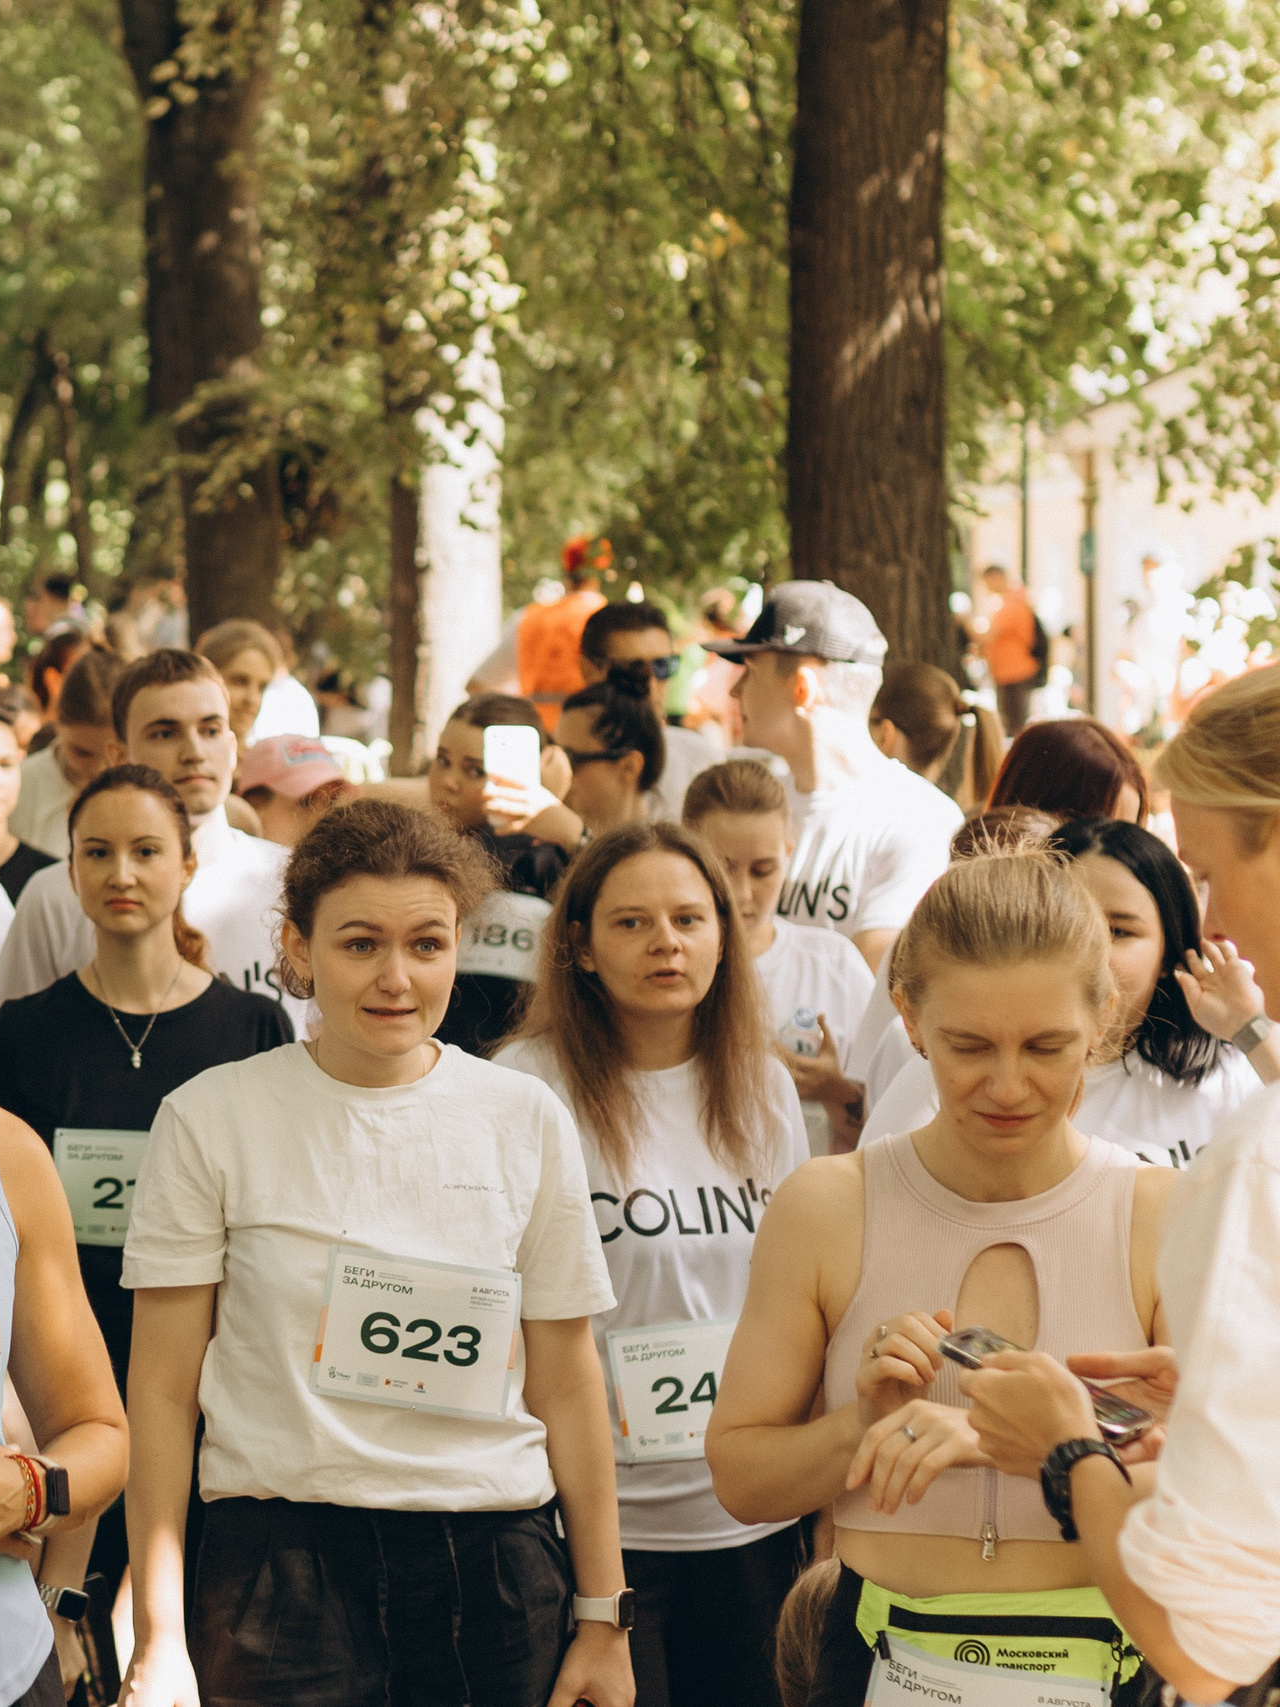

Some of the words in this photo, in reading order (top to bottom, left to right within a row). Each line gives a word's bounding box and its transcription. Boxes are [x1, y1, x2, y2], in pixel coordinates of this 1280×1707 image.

[93, 1177, 136, 1209] 2
[344, 1265, 375, 1278] БЕГИ
[342, 1275, 358, 1286] ЗА
[361, 1278, 413, 1295] ДРУГОМ
[479, 1287, 510, 1297] АВГУСТА
[360, 1311, 482, 1367] 623
[622, 1343, 650, 1354] БЕГИ
[624, 1354, 639, 1363] ЗА
[641, 1348, 685, 1362] ДРУГОМ
[996, 1648, 1069, 1659] Московский
[888, 1660, 918, 1680] БЕГИ
[886, 1671, 901, 1686] ЗА
[902, 1679, 962, 1705] ДРУГОМ
